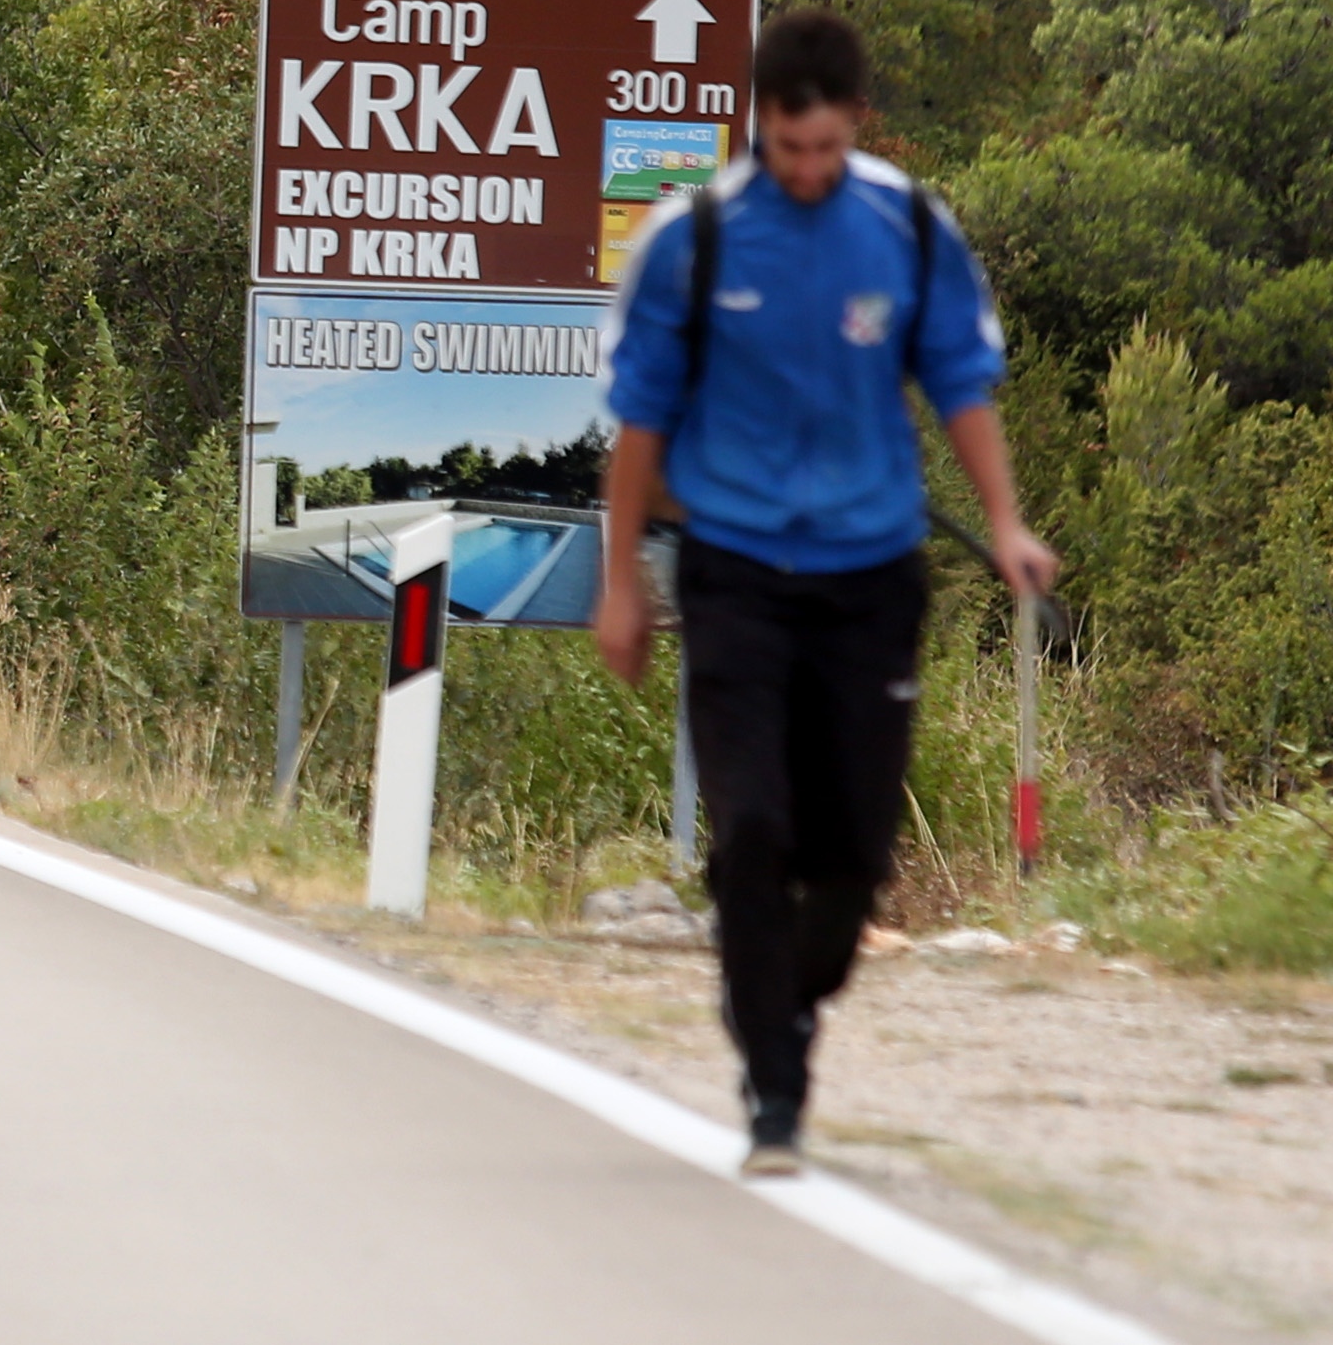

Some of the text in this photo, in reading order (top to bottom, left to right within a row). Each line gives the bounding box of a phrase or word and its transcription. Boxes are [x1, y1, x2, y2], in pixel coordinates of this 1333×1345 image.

[278, 58, 560, 157] KRKA
[605, 69, 735, 115] 300 m
[612, 147, 639, 169] CC
[275, 168, 544, 225] EXCURSION
[273, 226, 481, 281] NP KRKA
[265, 316, 403, 372] HEATED
